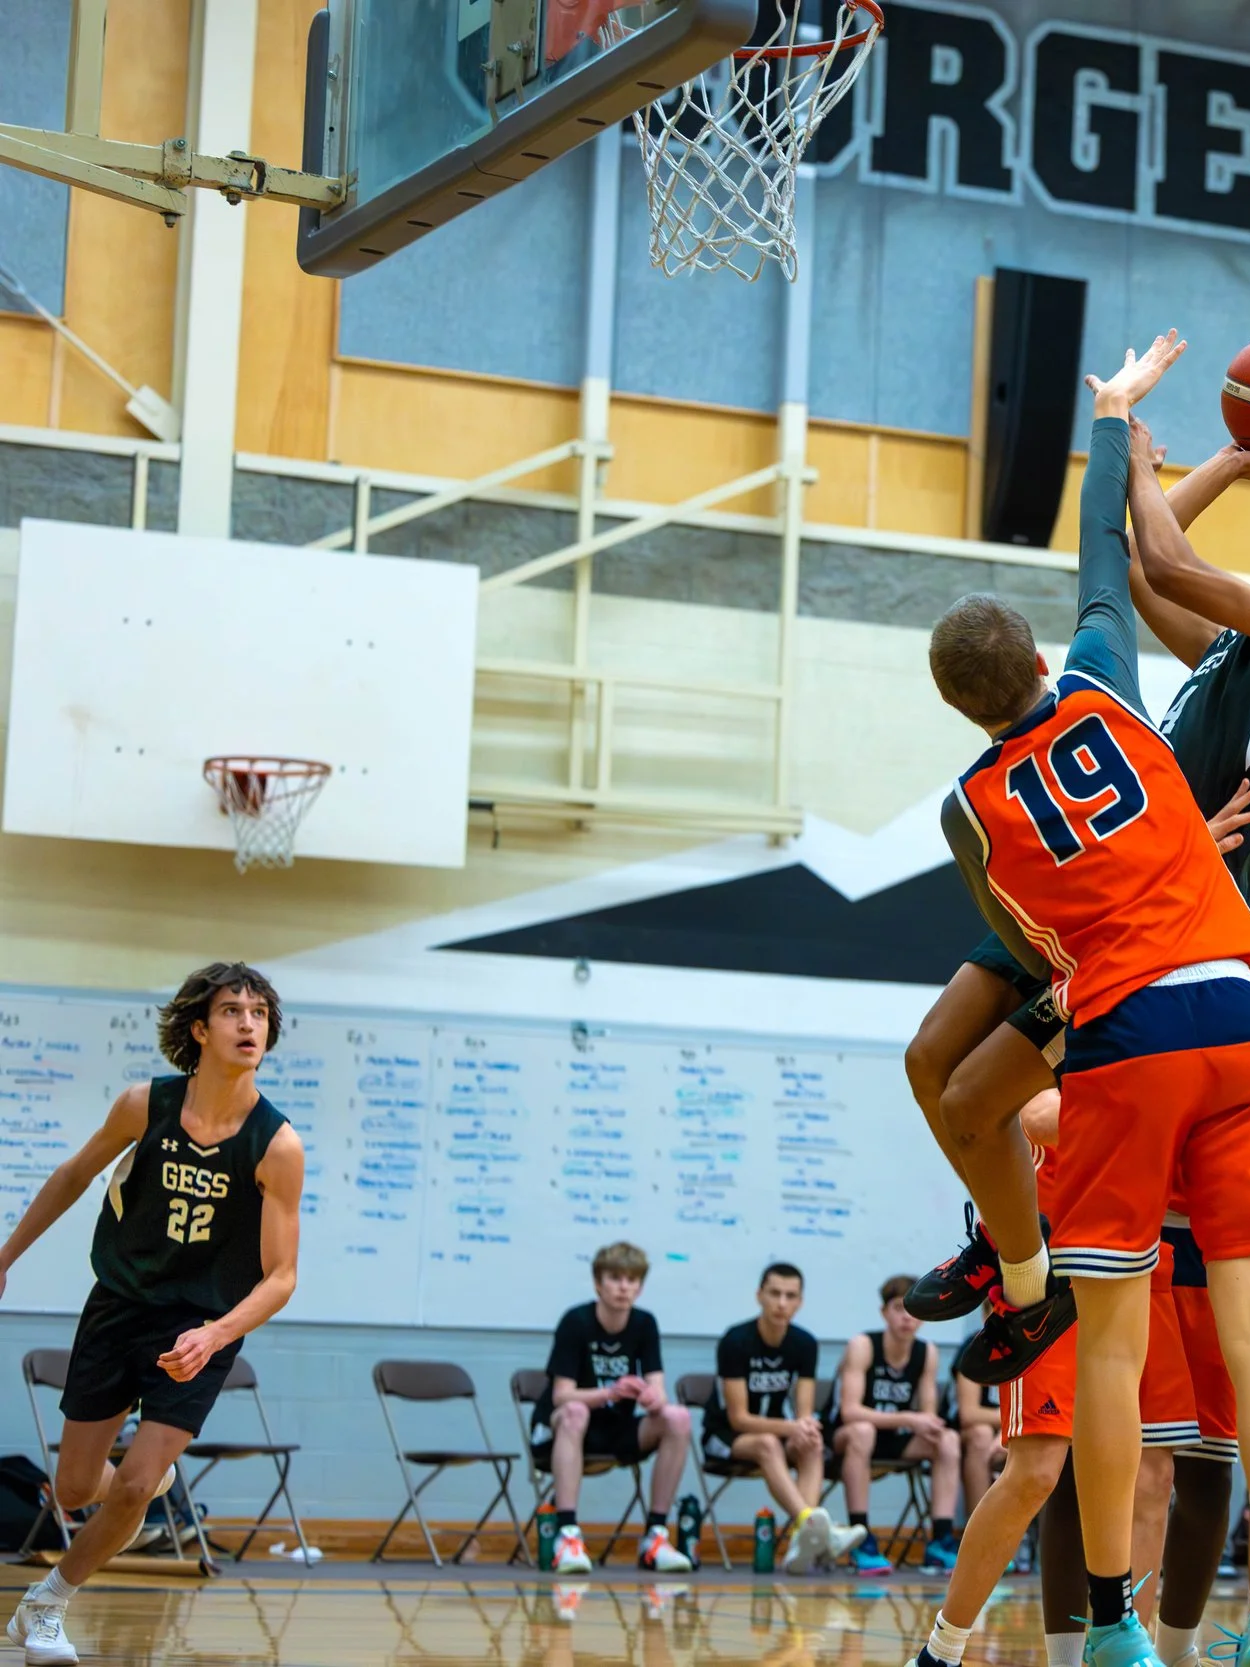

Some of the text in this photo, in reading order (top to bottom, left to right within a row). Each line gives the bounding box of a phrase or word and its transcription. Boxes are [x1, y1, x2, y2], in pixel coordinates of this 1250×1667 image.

[1005, 712, 1148, 868] 19
[162, 1161, 230, 1198] GESS
[167, 1197, 215, 1244] 22
